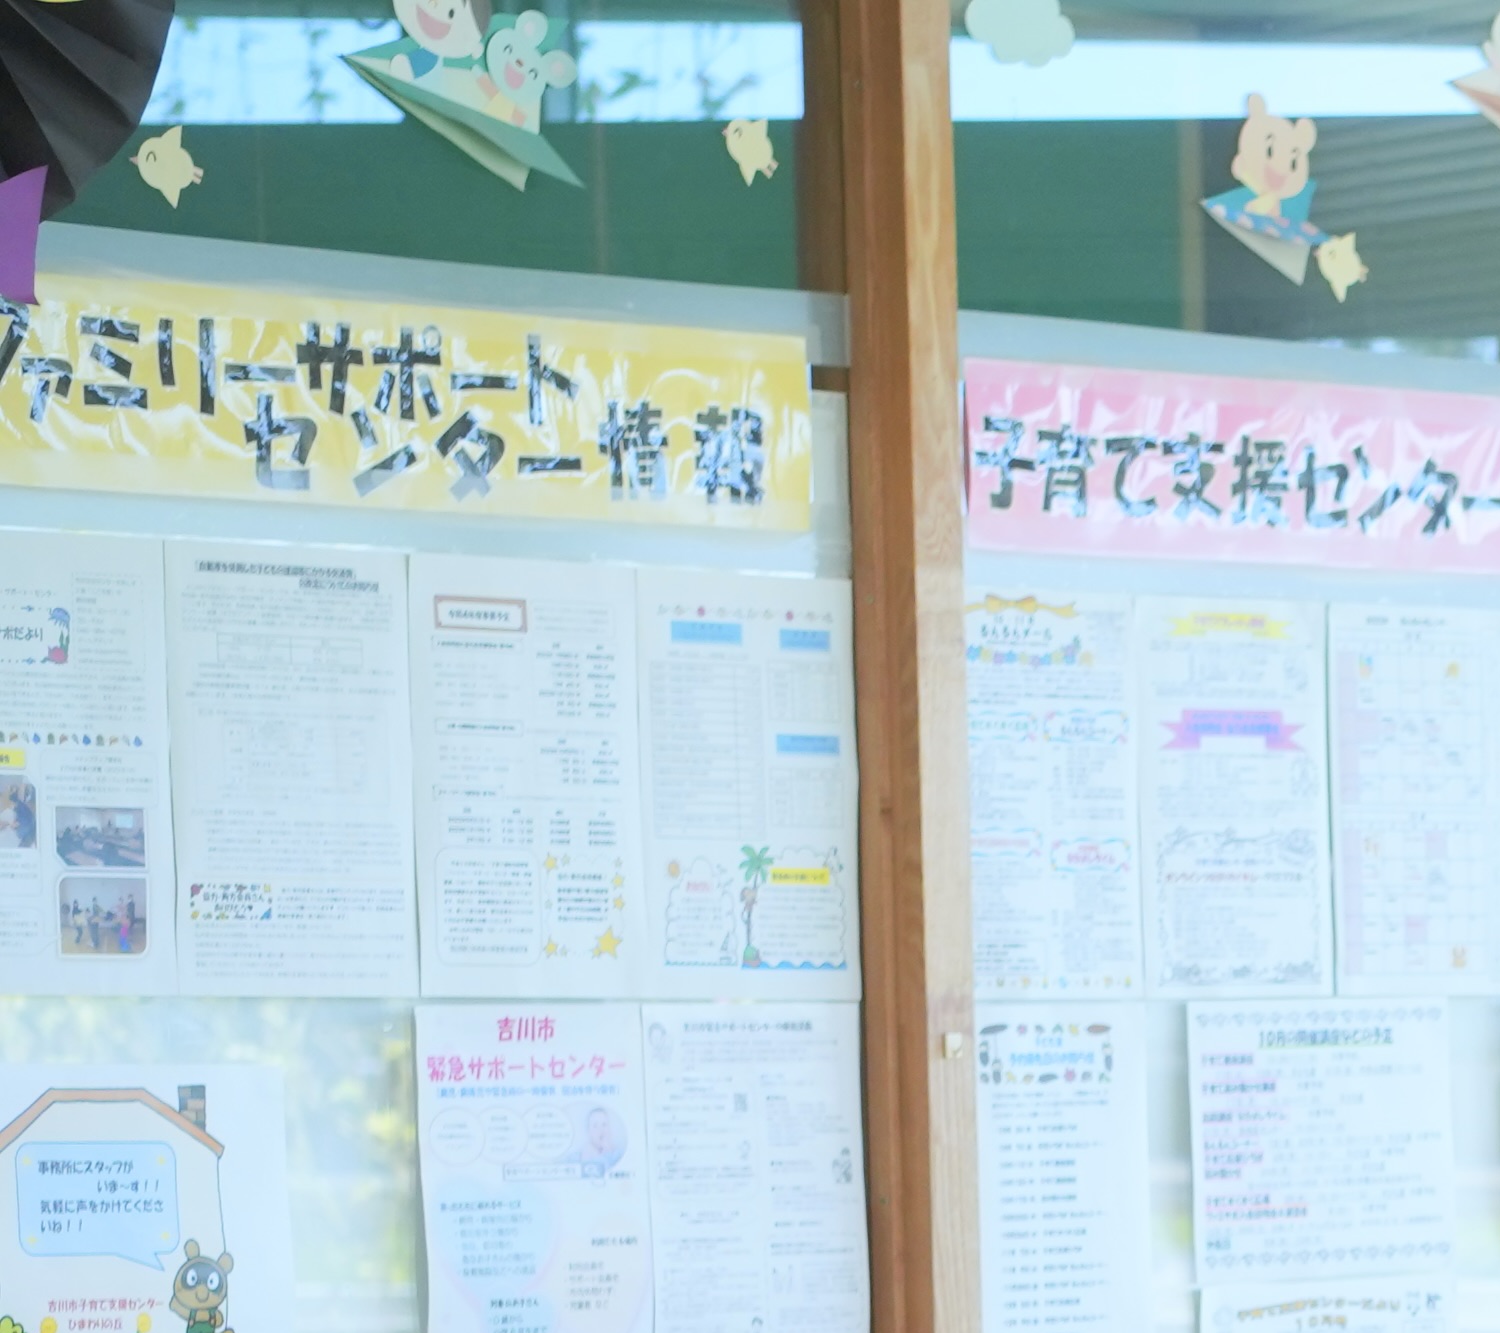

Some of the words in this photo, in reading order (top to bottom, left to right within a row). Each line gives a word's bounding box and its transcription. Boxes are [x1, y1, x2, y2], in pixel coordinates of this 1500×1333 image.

[243, 390, 766, 504] センター情報
[496, 1016, 556, 1042] 吉川市
[427, 1055, 628, 1083] 緊急サポートセンター
[38, 1160, 135, 1176] 事務所にスタッフが
[40, 1199, 166, 1215] 気軽に声をかけてくださ
[47, 1297, 165, 1313] 吉川市子育て支援センター
[67, 1317, 124, 1332] ひまわりの丘
